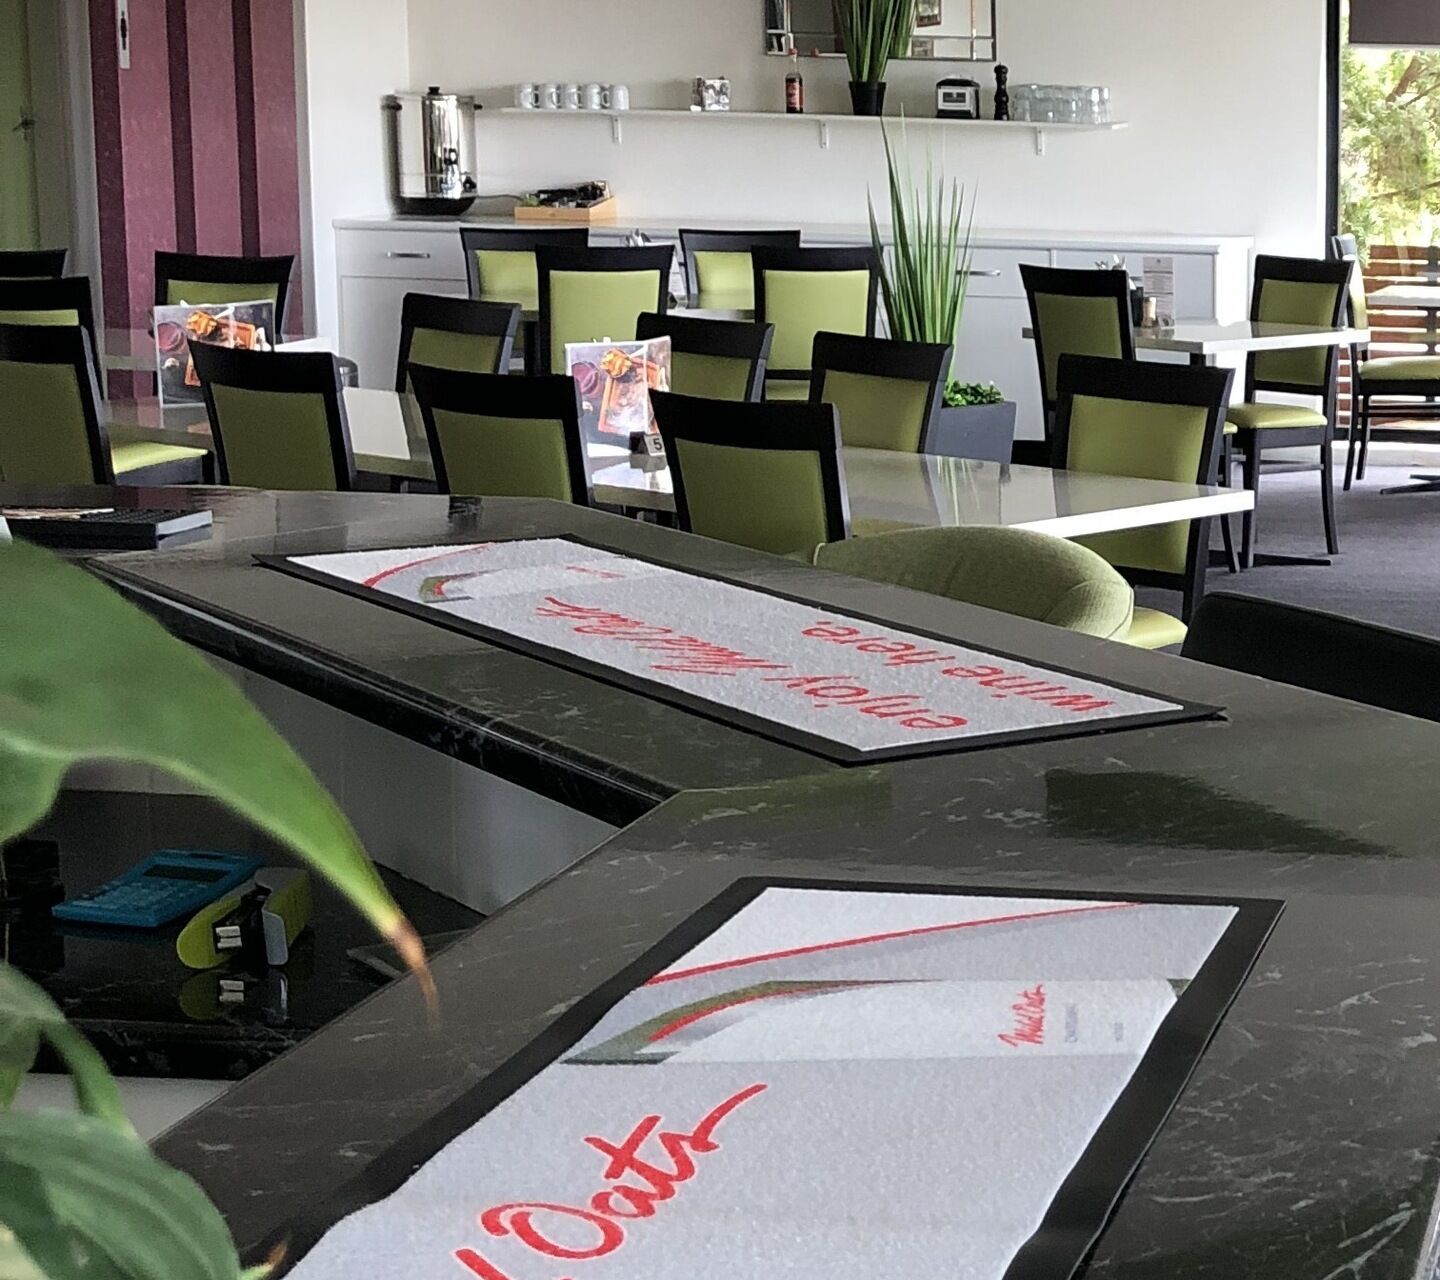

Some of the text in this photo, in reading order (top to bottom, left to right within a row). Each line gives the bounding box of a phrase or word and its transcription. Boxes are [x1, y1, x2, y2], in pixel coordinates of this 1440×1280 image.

[652, 437, 663, 451] 5
[760, 675, 968, 730] enjoy
[801, 621, 1117, 712] wine here.
[480, 1083, 769, 1261] Oats
